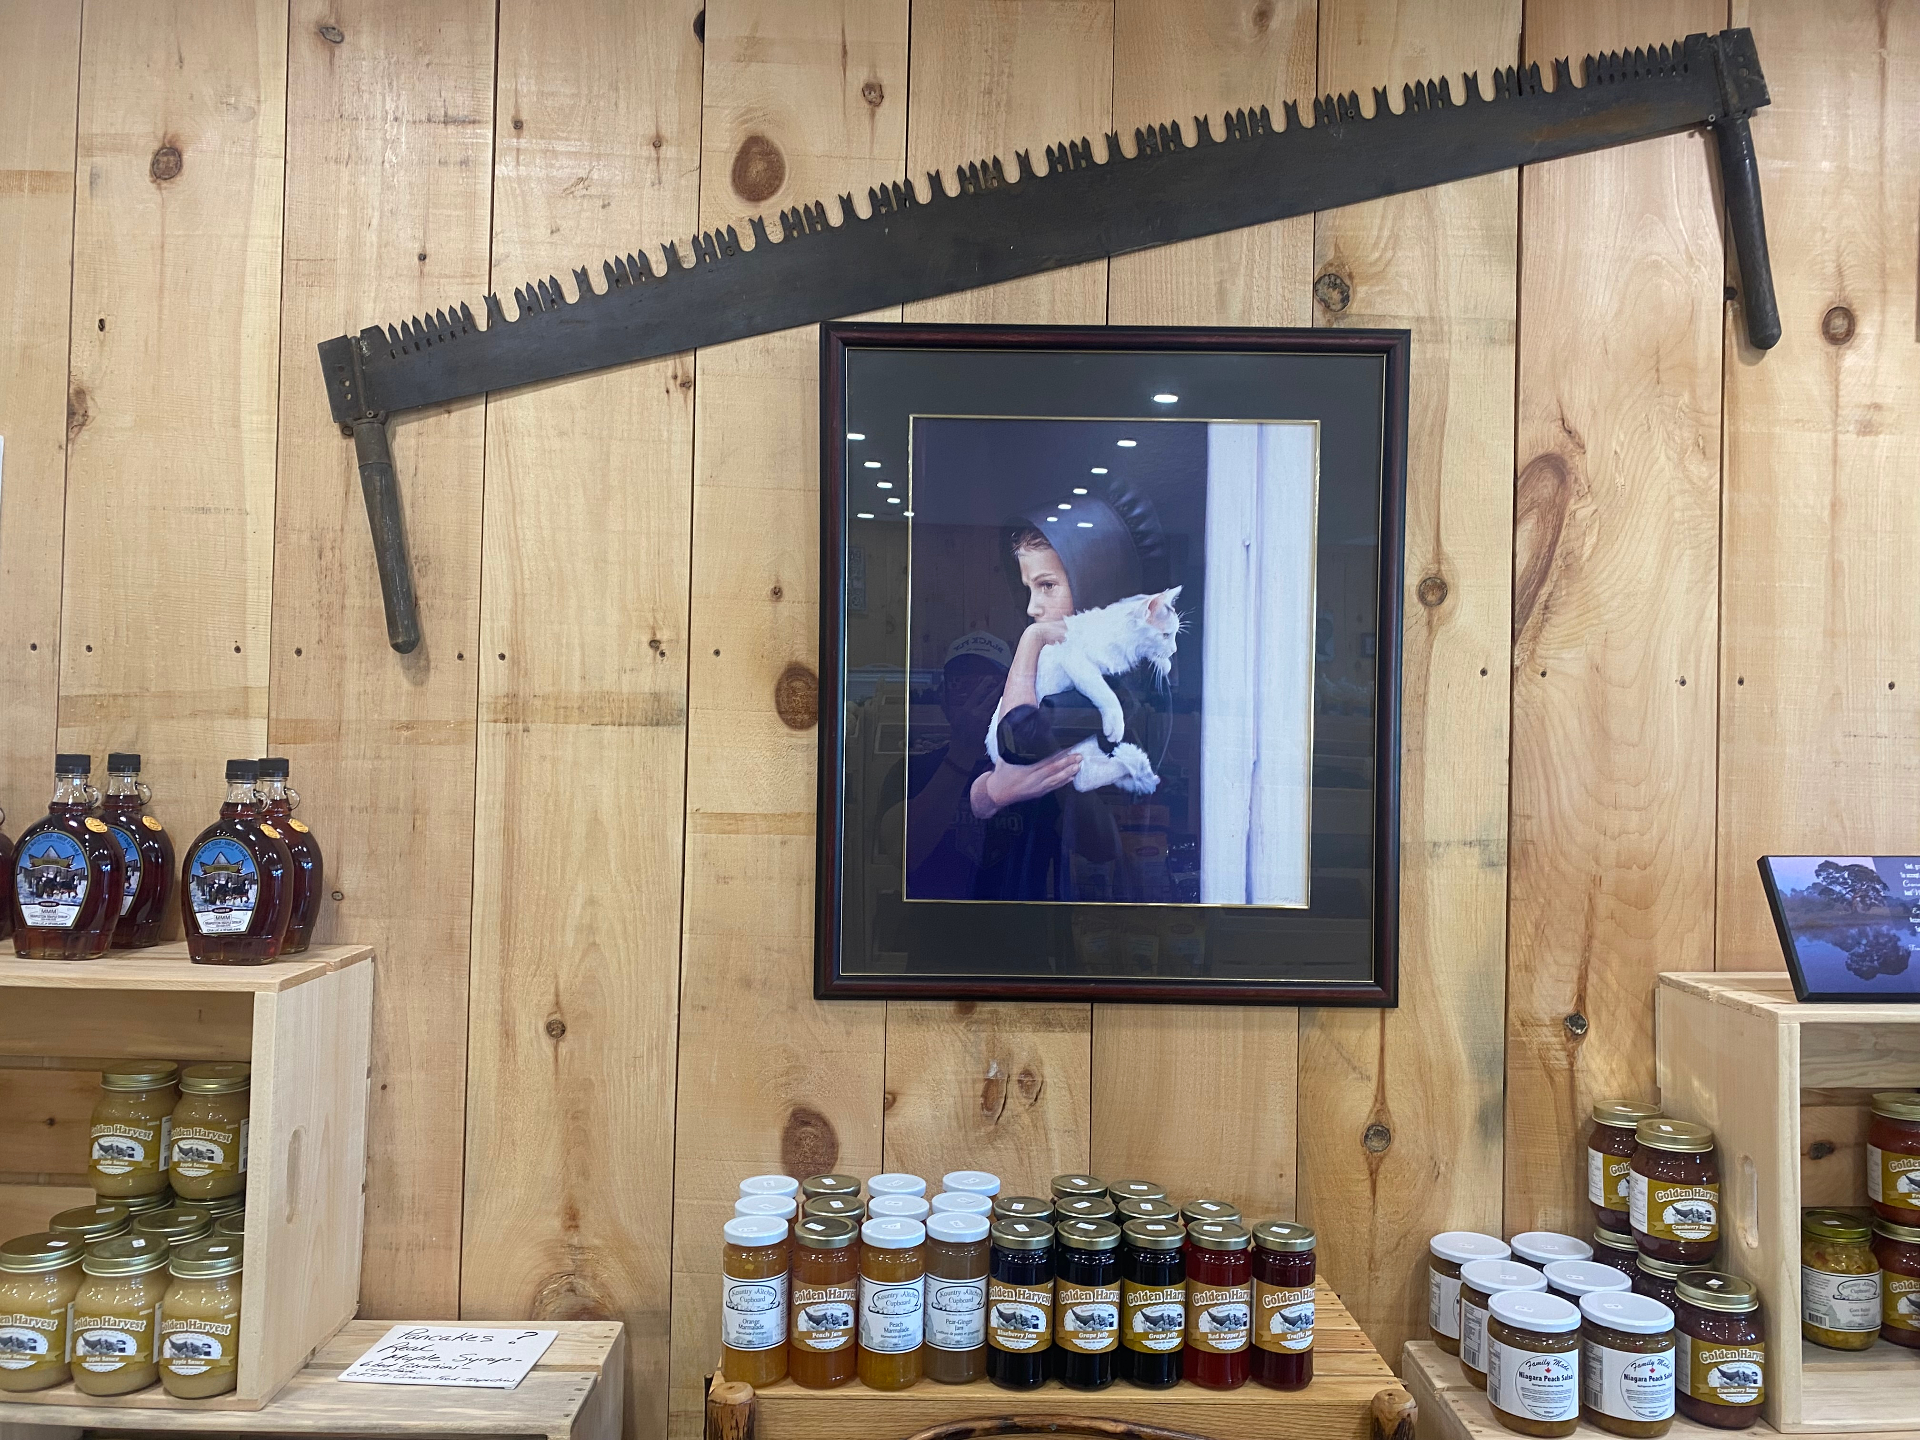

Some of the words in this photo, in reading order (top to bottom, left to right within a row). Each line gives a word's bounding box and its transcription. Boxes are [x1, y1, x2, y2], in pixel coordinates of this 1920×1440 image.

[114, 1124, 153, 1141] Harvest
[193, 1127, 233, 1144] Harvest
[1655, 1188, 1692, 1203] Golden
[794, 1289, 826, 1305] Golden
[989, 1286, 1015, 1300] olden
[1059, 1289, 1093, 1304] Golden
[1127, 1290, 1163, 1306] Golden
[1193, 1290, 1229, 1306] Golden
[1263, 1291, 1301, 1308] Golden
[886, 1299, 911, 1308] Cupboard
[949, 1297, 974, 1305] Cupboard
[13, 1313, 58, 1331] Harvest
[101, 1316, 146, 1332] Harvest
[187, 1318, 231, 1336] Harvest
[742, 1318, 760, 1326] Orange
[946, 1318, 973, 1326] Pear-Ginger
[397, 1328, 494, 1342] Pancakes
[1699, 1349, 1739, 1364] Golden
[1525, 1359, 1550, 1370] Family
[1552, 1358, 1570, 1371] Made
[1631, 1359, 1655, 1372] Family
[1519, 1371, 1543, 1382] Niagara
[1623, 1373, 1647, 1383] Niagara
